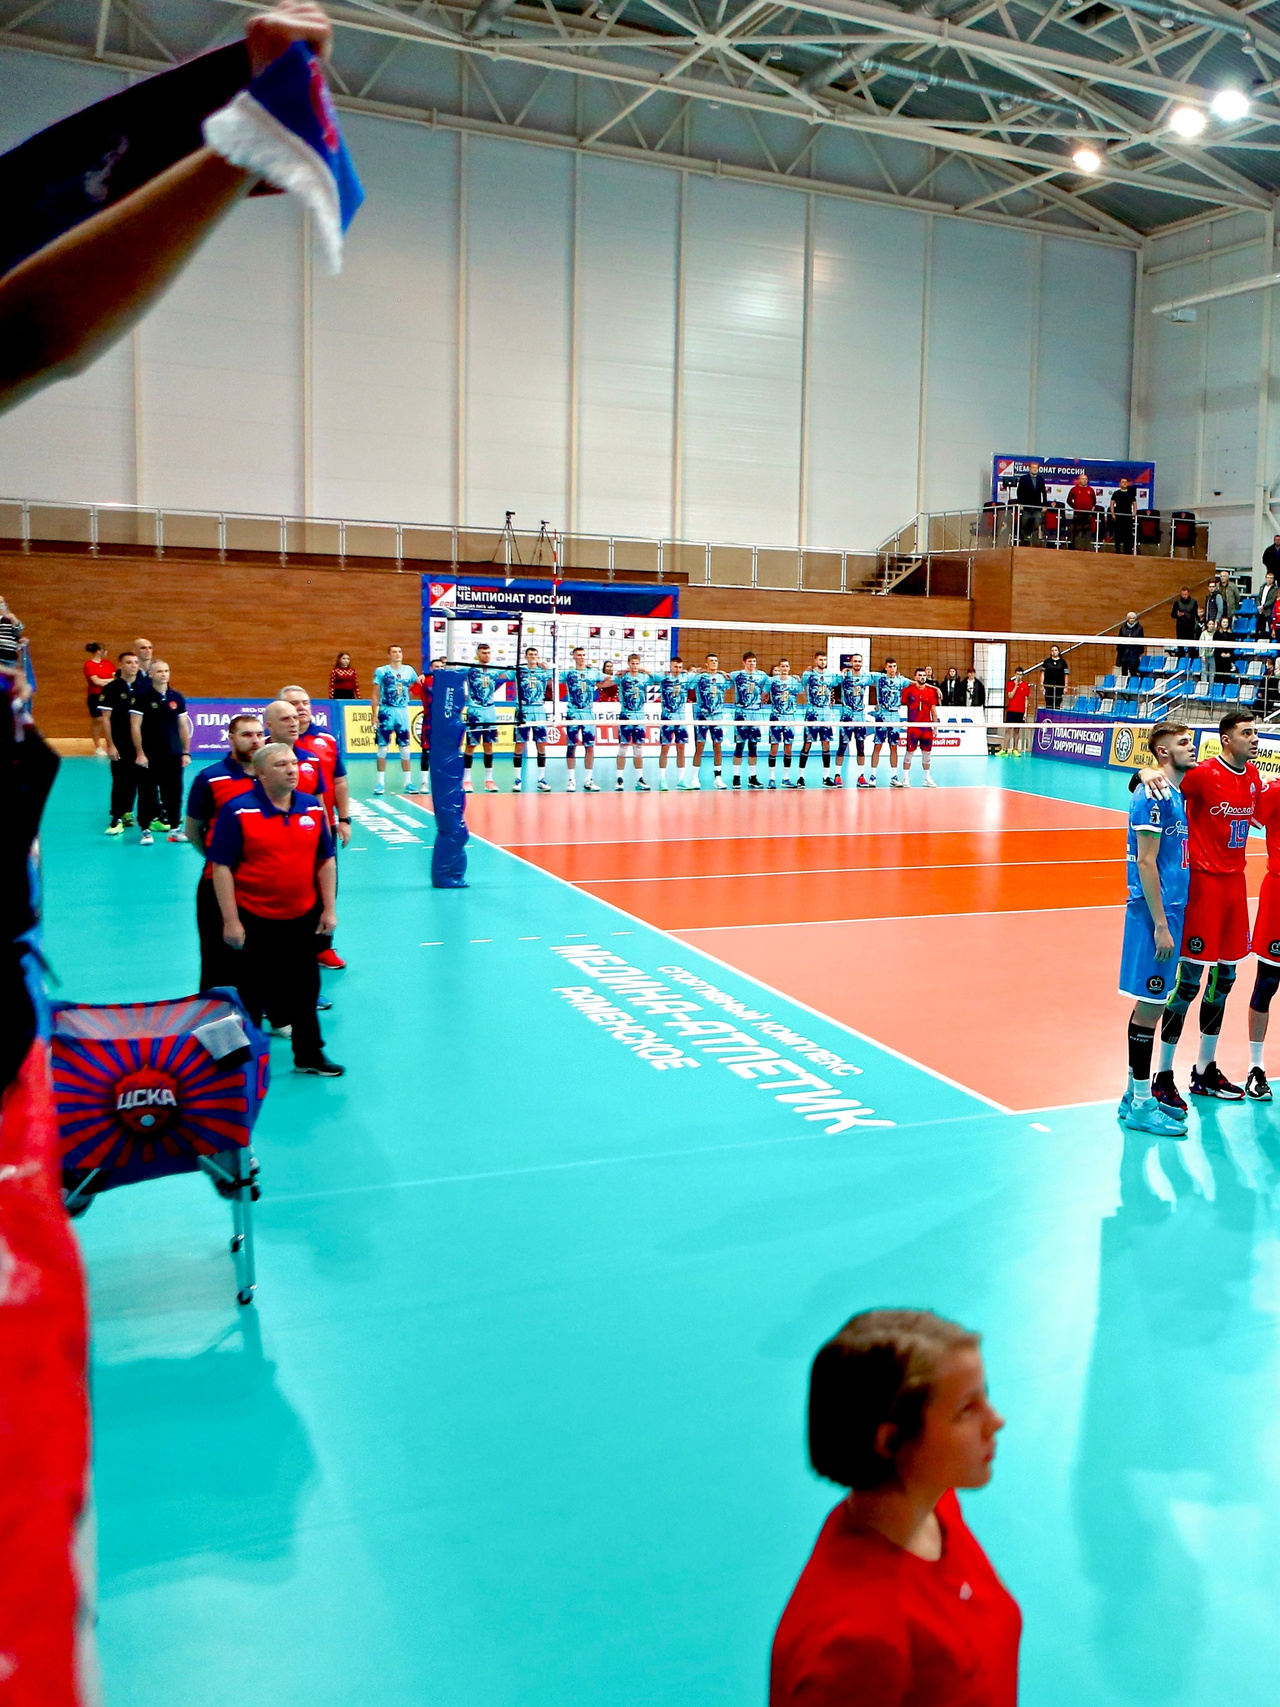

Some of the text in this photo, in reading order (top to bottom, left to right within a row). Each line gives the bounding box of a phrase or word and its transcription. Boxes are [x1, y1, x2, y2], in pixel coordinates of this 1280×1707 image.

[1014, 465, 1086, 475] ЧЕМОНАТ РОССИИ
[456, 591, 572, 606] ЧЕМПИОНАТ РОССИИ
[1053, 740, 1085, 754] ХИРУРГИИ
[1054, 728, 1104, 744] ПЛАСТИЧЕСКОЙ
[1228, 819, 1249, 849] 19
[551, 985, 702, 1071] РАМЕНСКОЕ
[656, 965, 865, 1077] СПОРТИВНЫЙ КОМПЛЕКС
[549, 943, 897, 1134] МЕДИНА-АТЛЕТИК
[116, 1087, 178, 1111] ЦСКА
